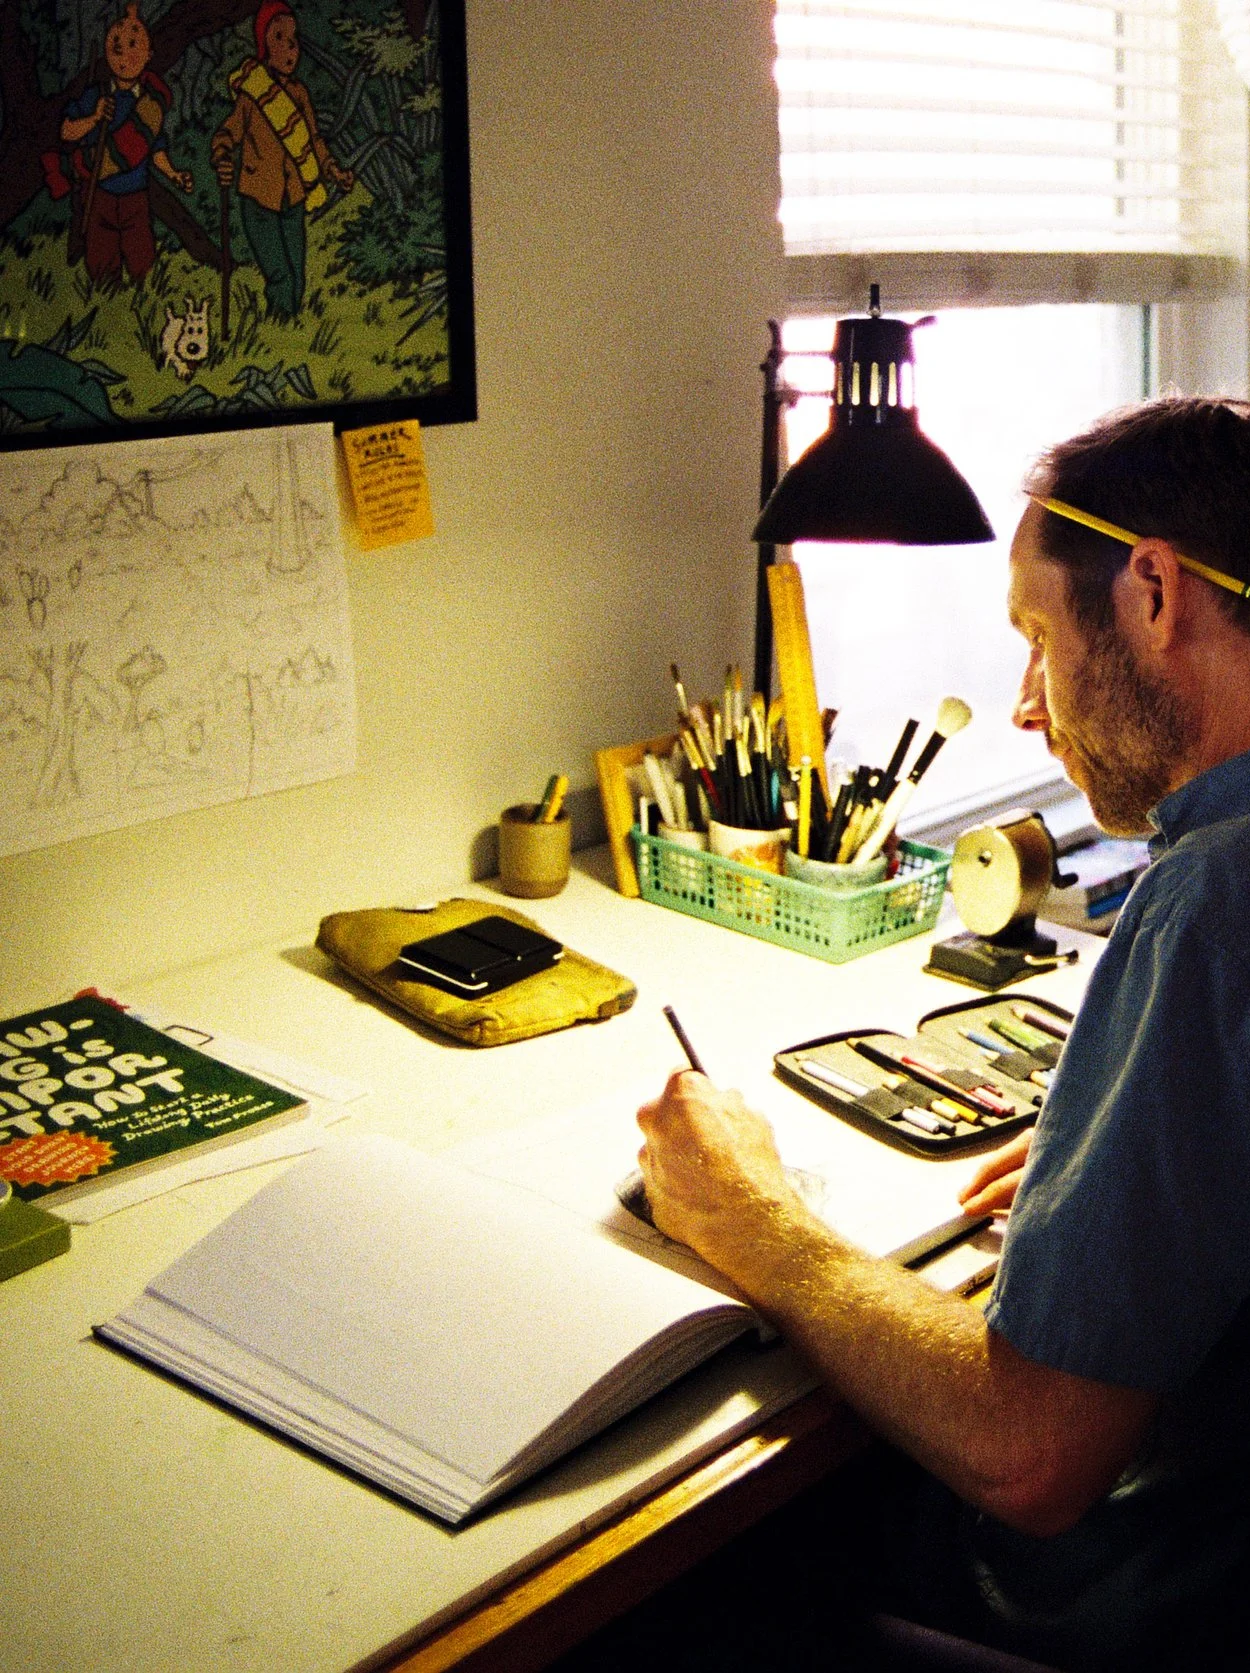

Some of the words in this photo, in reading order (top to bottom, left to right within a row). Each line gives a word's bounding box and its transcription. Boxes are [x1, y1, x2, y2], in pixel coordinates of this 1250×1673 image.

[93, 1116, 129, 1130] How
[121, 1116, 191, 1141] Drawing
[191, 1094, 255, 1119] Practice
